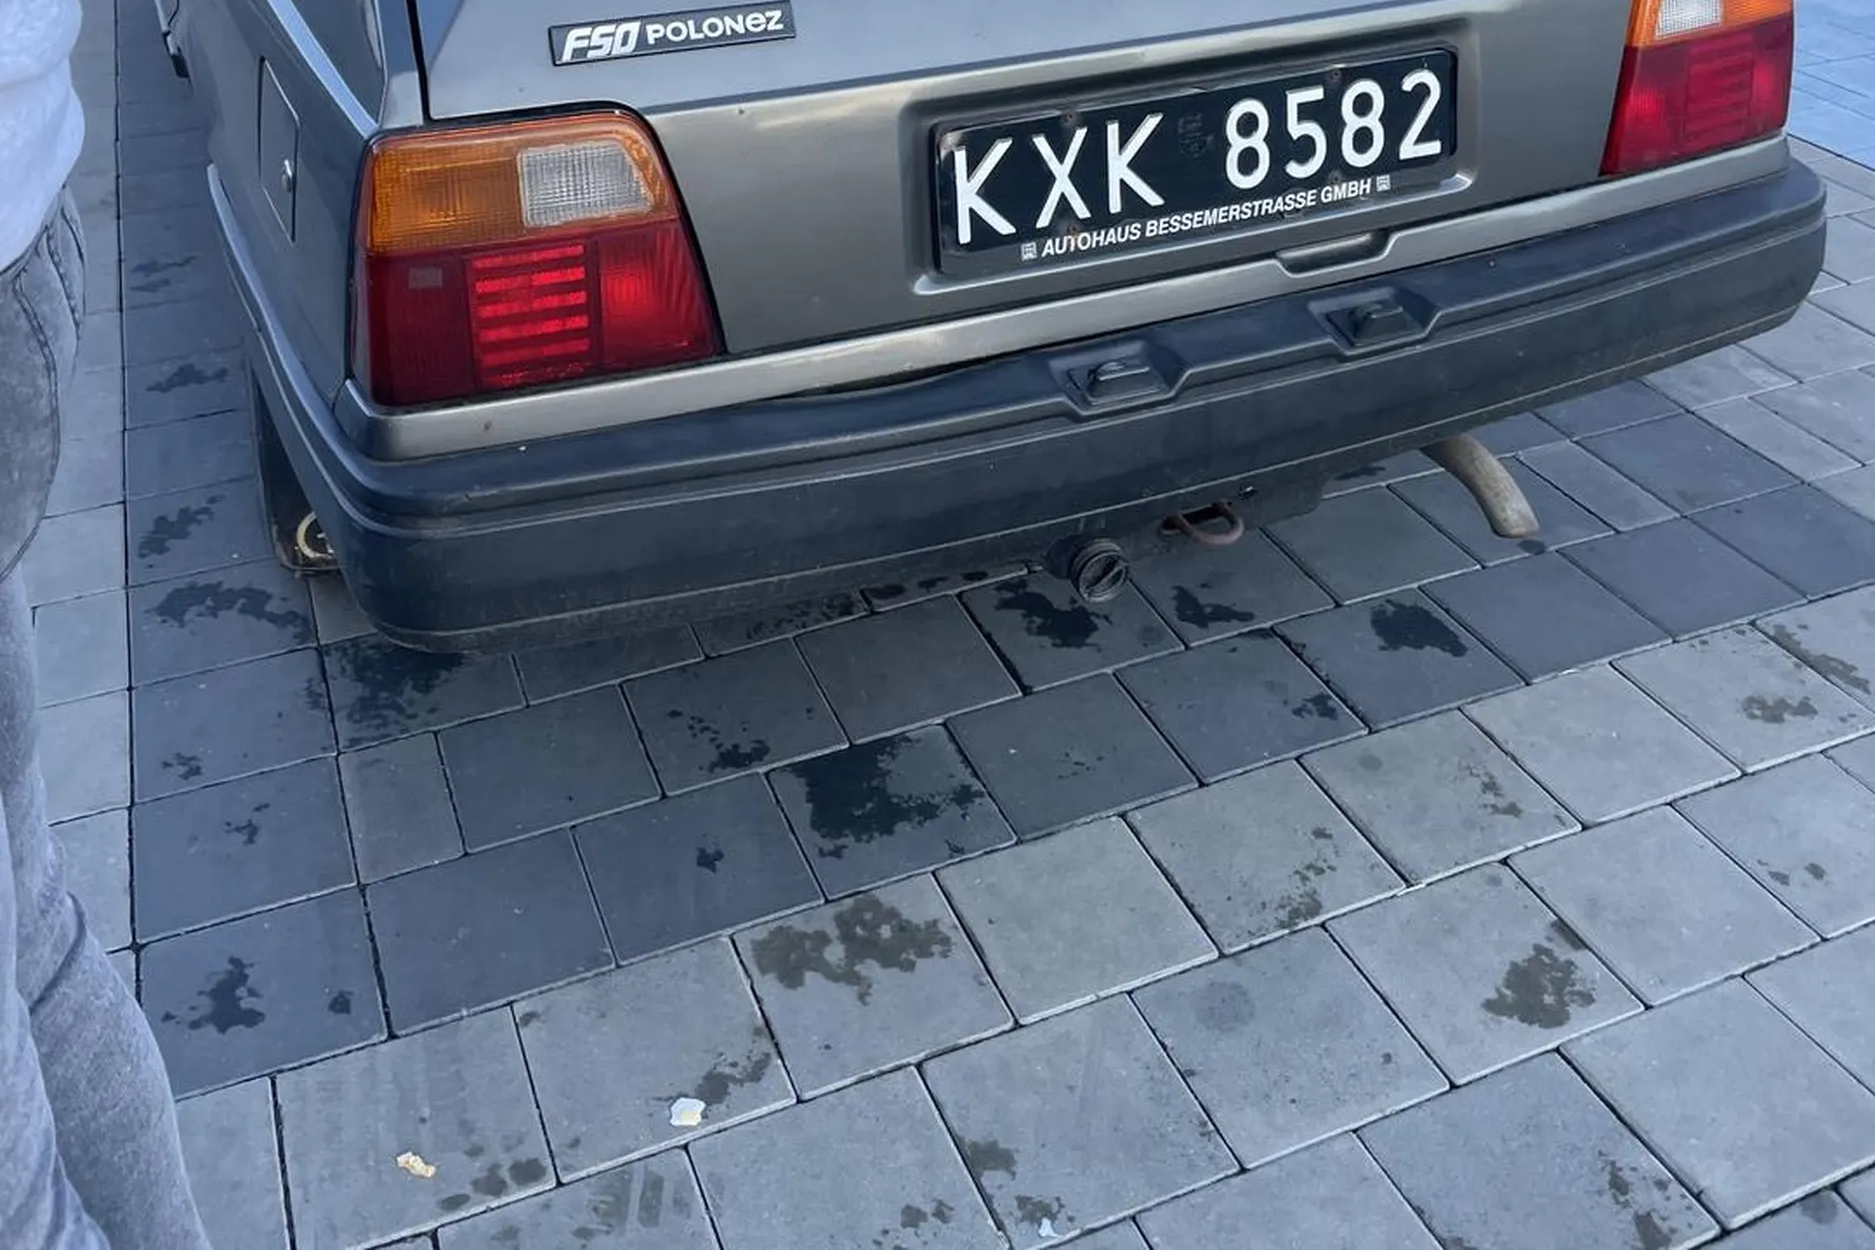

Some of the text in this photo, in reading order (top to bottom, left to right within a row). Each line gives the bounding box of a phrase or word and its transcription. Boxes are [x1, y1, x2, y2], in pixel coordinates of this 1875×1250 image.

[561, 20, 642, 63] FSO
[954, 68, 1442, 245] KXK 8582
[1041, 178, 1372, 258] AUTOHAUS BESSEMERSTRASSE GMBH
